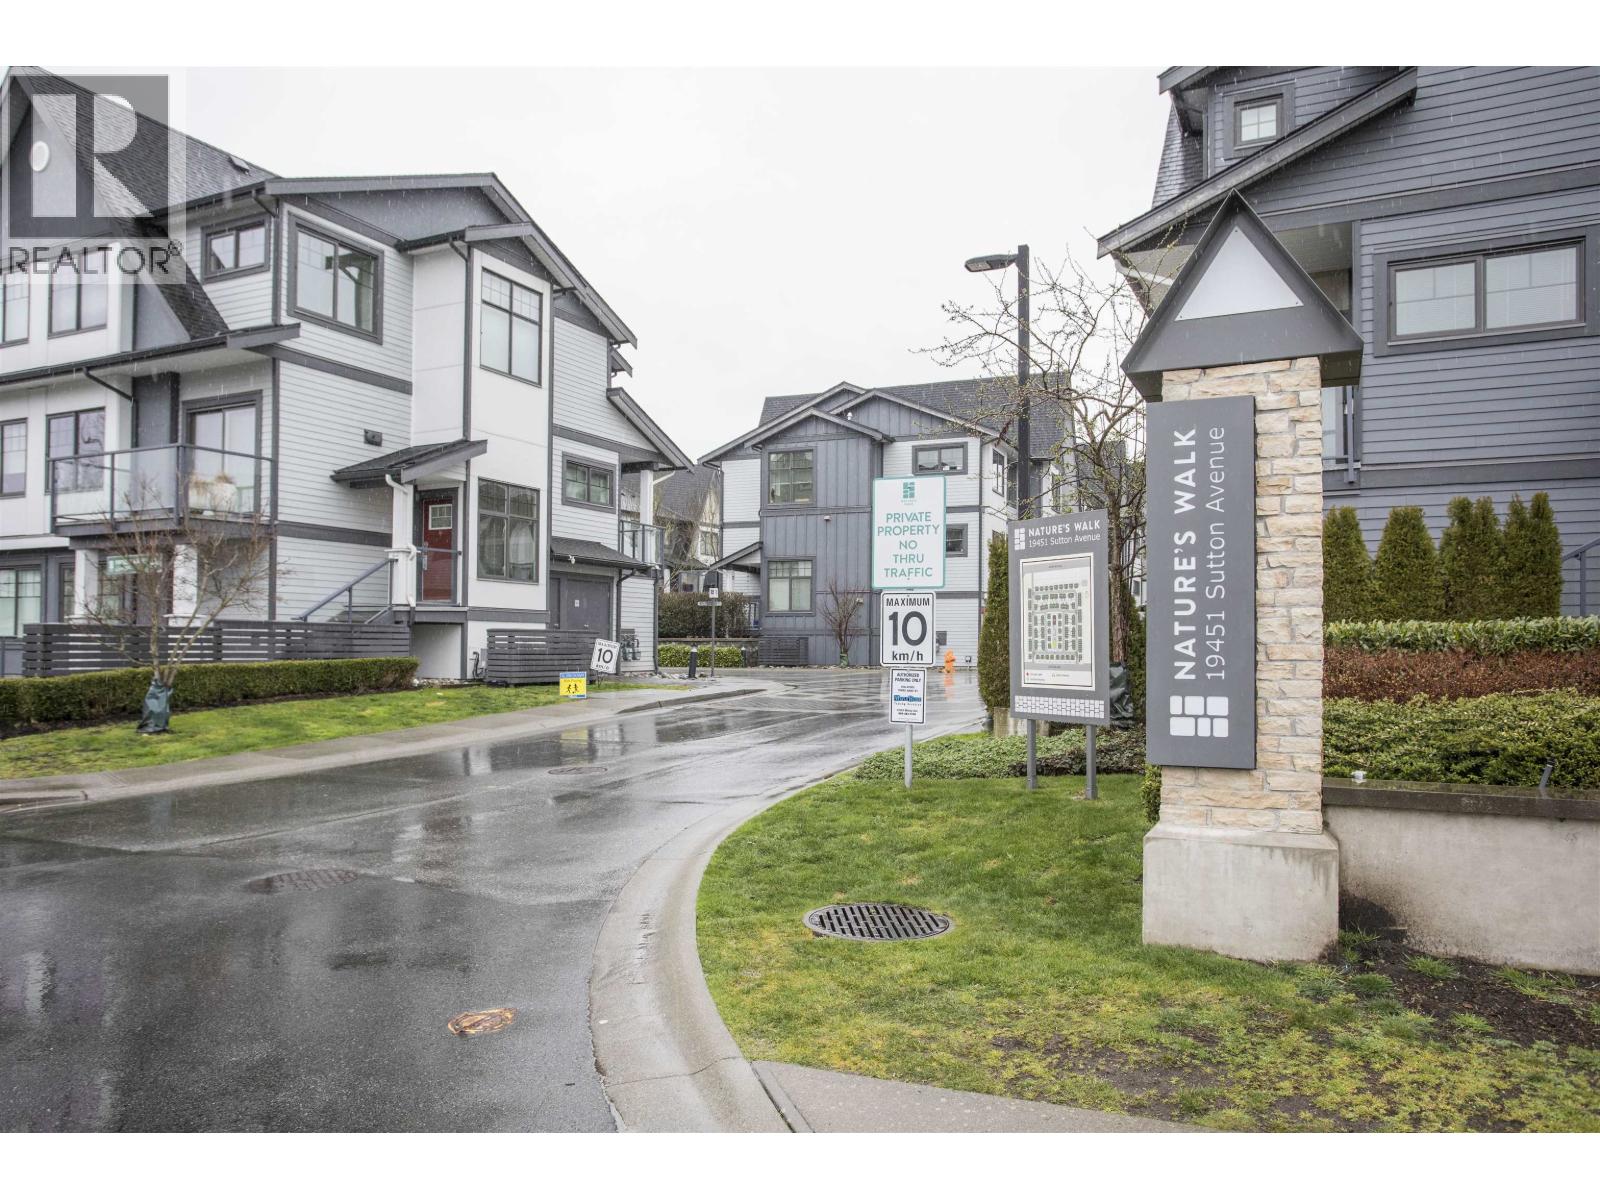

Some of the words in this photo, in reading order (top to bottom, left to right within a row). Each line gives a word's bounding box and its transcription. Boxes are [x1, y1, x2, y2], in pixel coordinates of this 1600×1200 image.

[1173, 428, 1197, 514] WALK
[1205, 427, 1226, 513] Avenue
[886, 511, 932, 523] PRIVATE
[877, 524, 940, 536] PROPERTY
[1028, 523, 1070, 537] NATURE'S
[1074, 520, 1101, 532] WALK
[899, 539, 918, 550] NO
[1029, 537, 1049, 548] 19451
[1050, 535, 1073, 546] Sutton
[1074, 533, 1101, 543] Avenue
[893, 553, 924, 564] THRU
[1205, 522, 1226, 599] Sutton
[884, 567, 933, 578] TRAFFIC
[886, 597, 930, 607] MAXIMUM
[1173, 530, 1197, 680] NATURE'S
[888, 611, 928, 646] 10
[1205, 611, 1226, 680] 19451
[598, 648, 613, 663] 10
[892, 650, 924, 661] km/h
